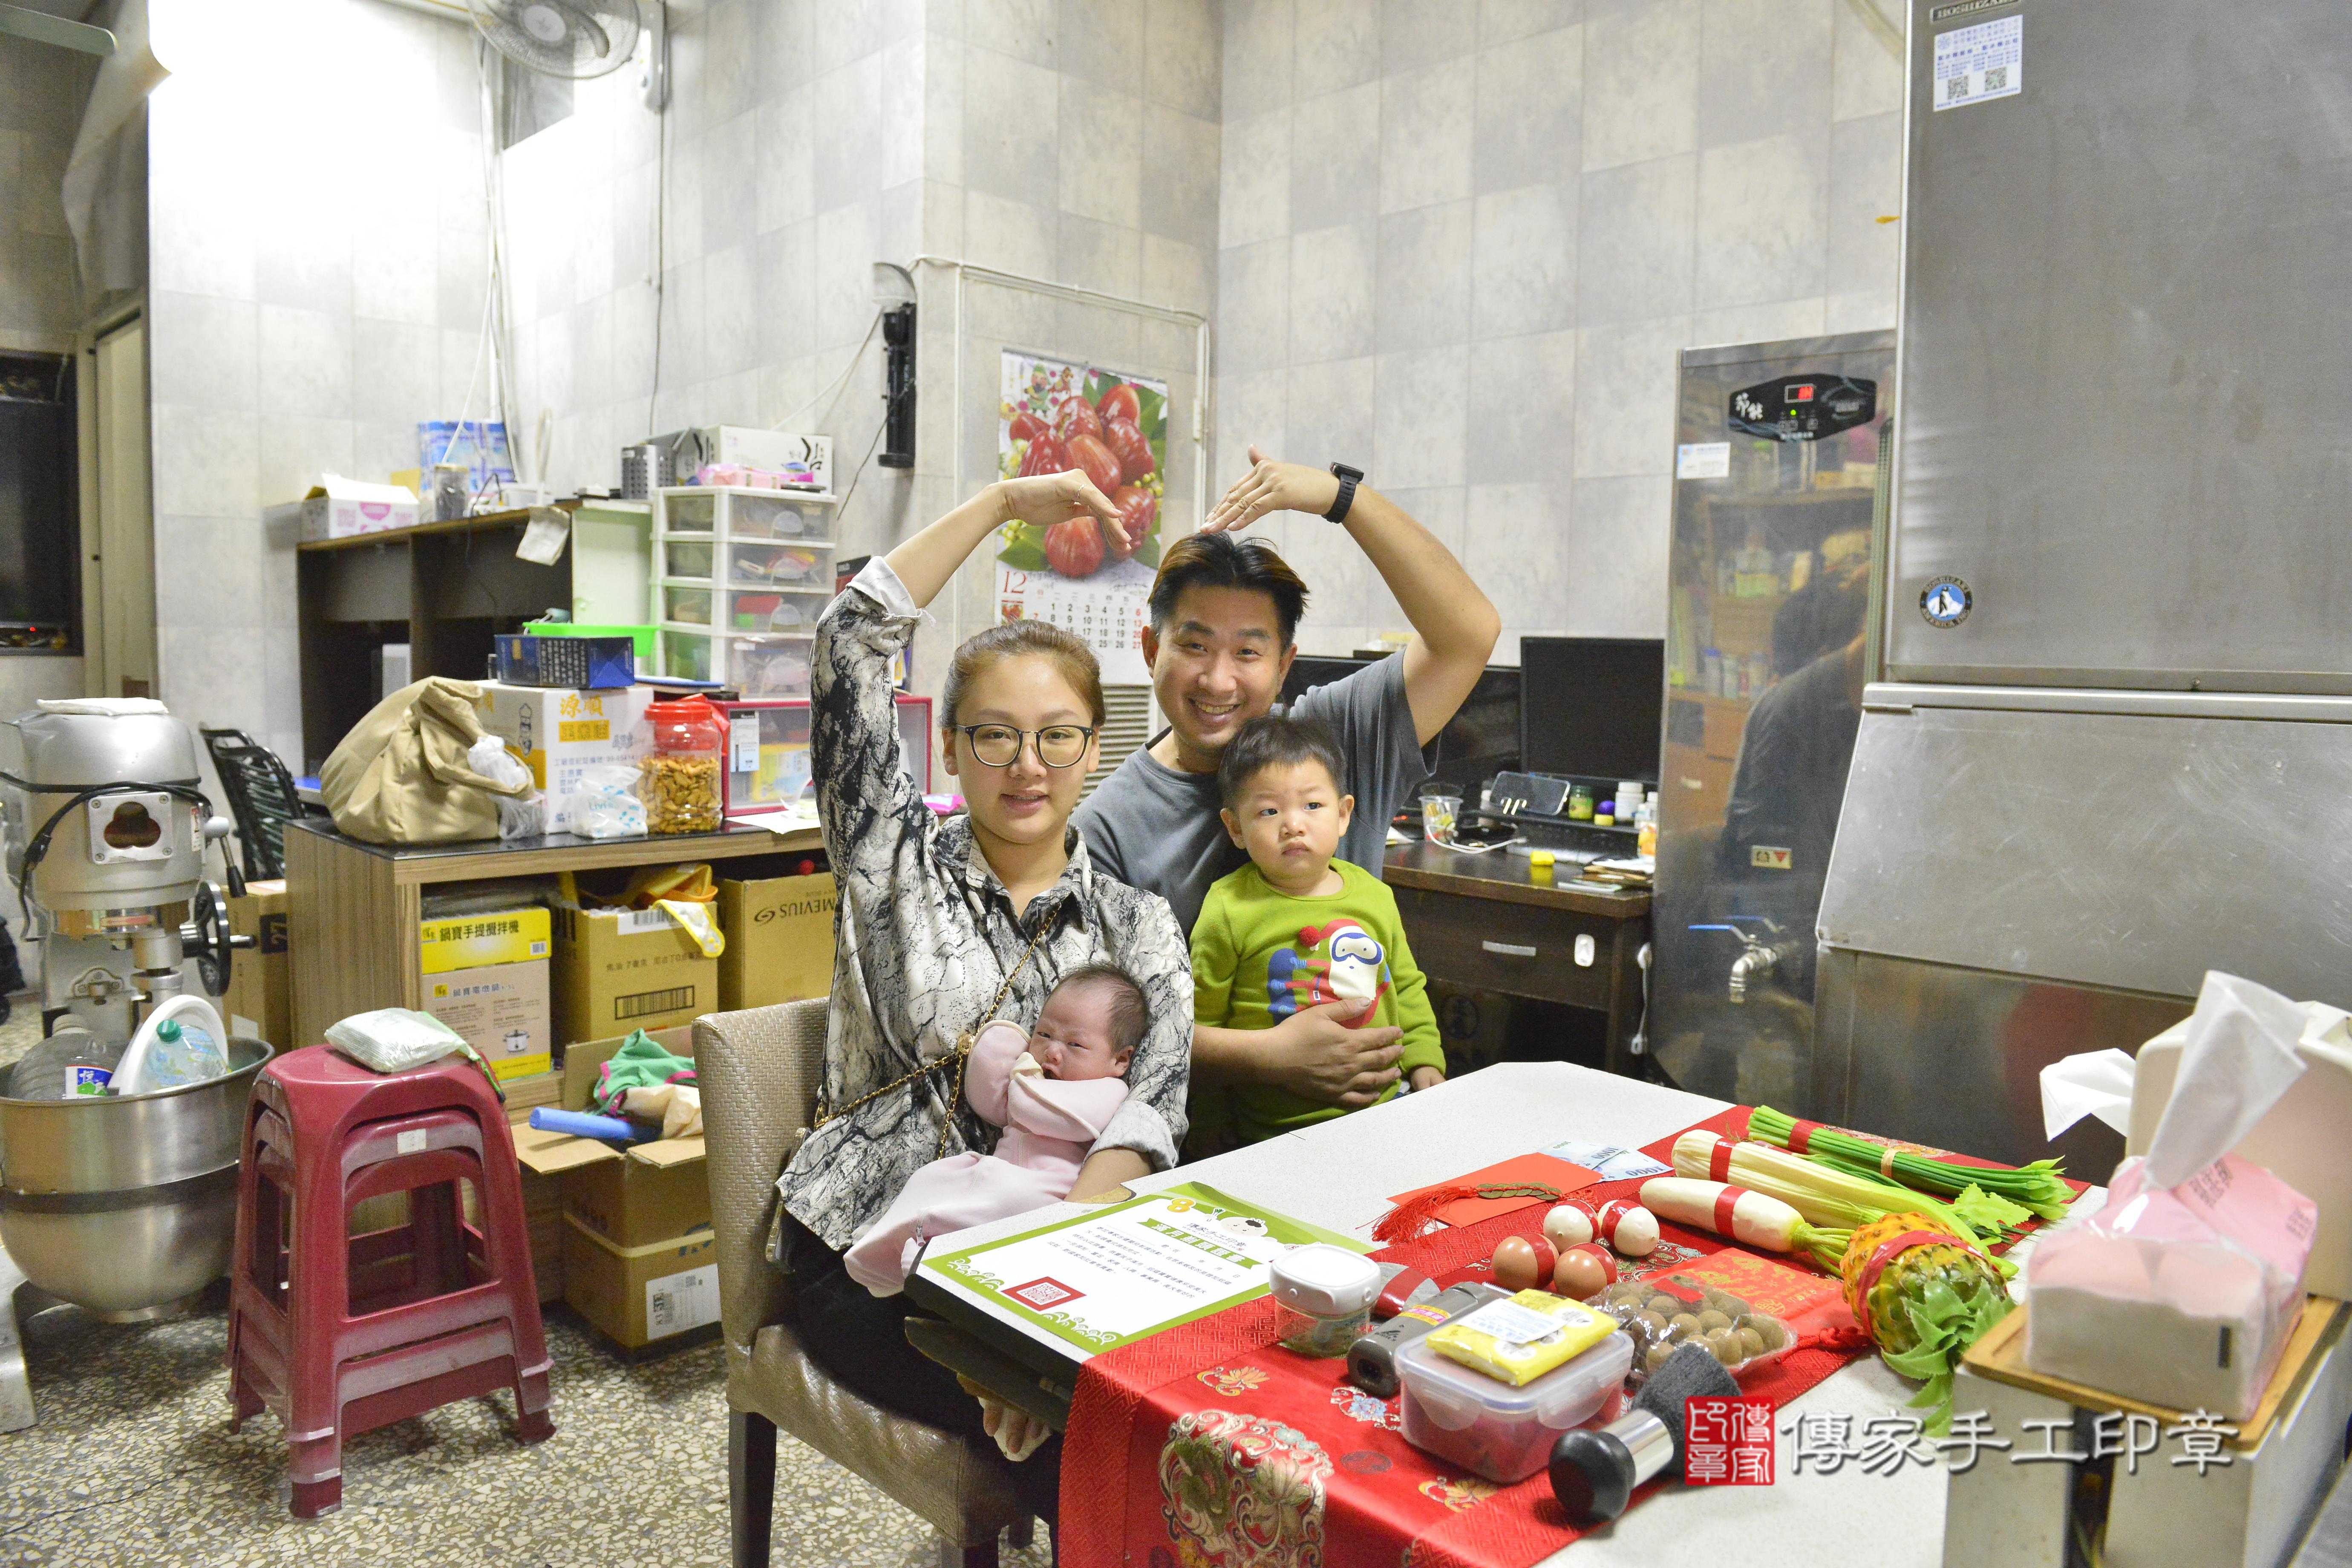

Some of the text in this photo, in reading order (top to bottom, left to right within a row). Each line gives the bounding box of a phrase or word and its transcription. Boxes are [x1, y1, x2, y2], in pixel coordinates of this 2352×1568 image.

[1003, 571, 1026, 594] 12
[1119, 607, 1124, 615] 5
[1051, 614, 1055, 622] 8
[1067, 615, 1072, 623] 9
[1083, 617, 1092, 625] 10
[1134, 619, 1142, 627] 13
[1099, 640, 1107, 648] 25
[780, 897, 835, 918] MEVIUS
[1591, 1147, 1619, 1159] 1000
[1625, 1166, 1666, 1177] 1000
[1150, 1223, 1247, 1263] 滿月剃頭證書
